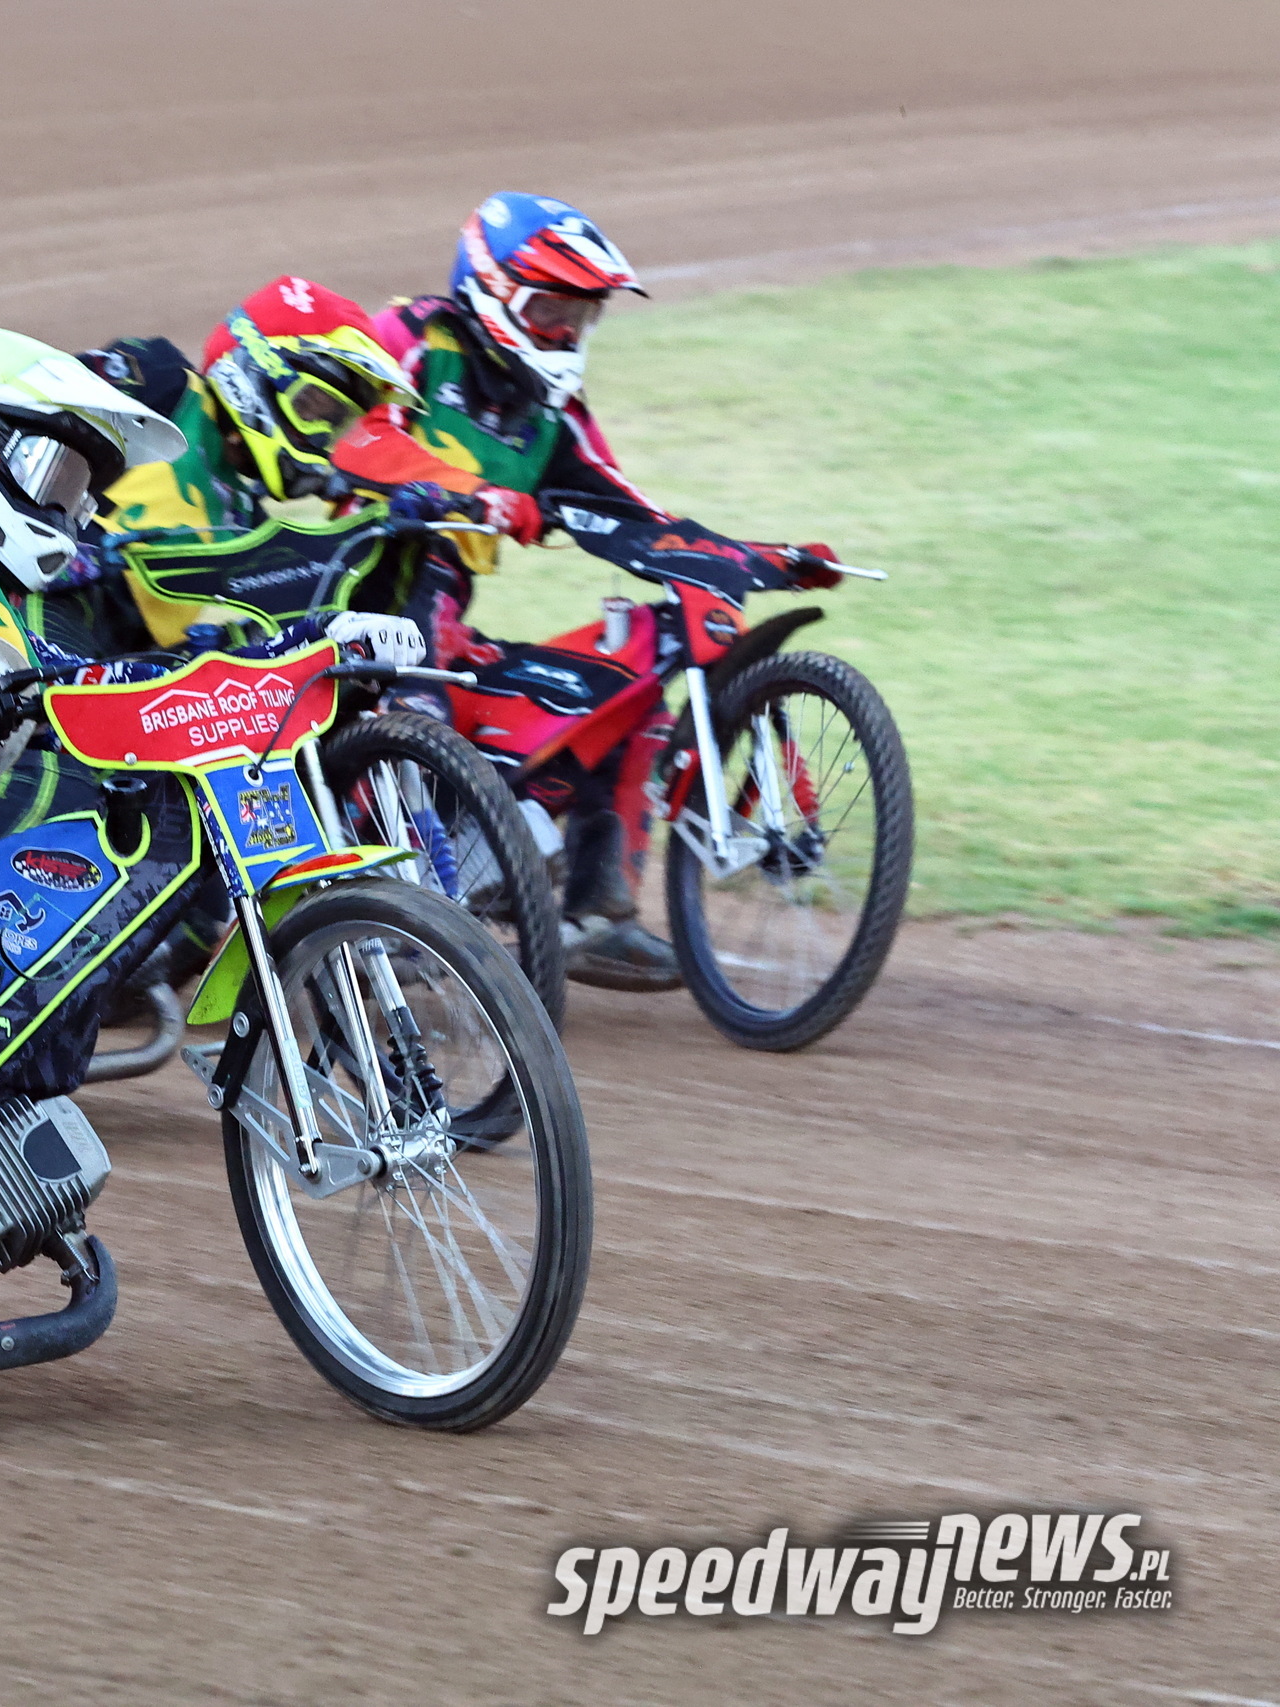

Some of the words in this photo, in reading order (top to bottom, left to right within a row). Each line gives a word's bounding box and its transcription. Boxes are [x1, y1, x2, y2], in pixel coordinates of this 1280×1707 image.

[141, 698, 219, 734] BRISBANE
[217, 691, 258, 715] ROOF
[258, 688, 295, 708] TILING
[188, 712, 280, 747] SUPPLIES
